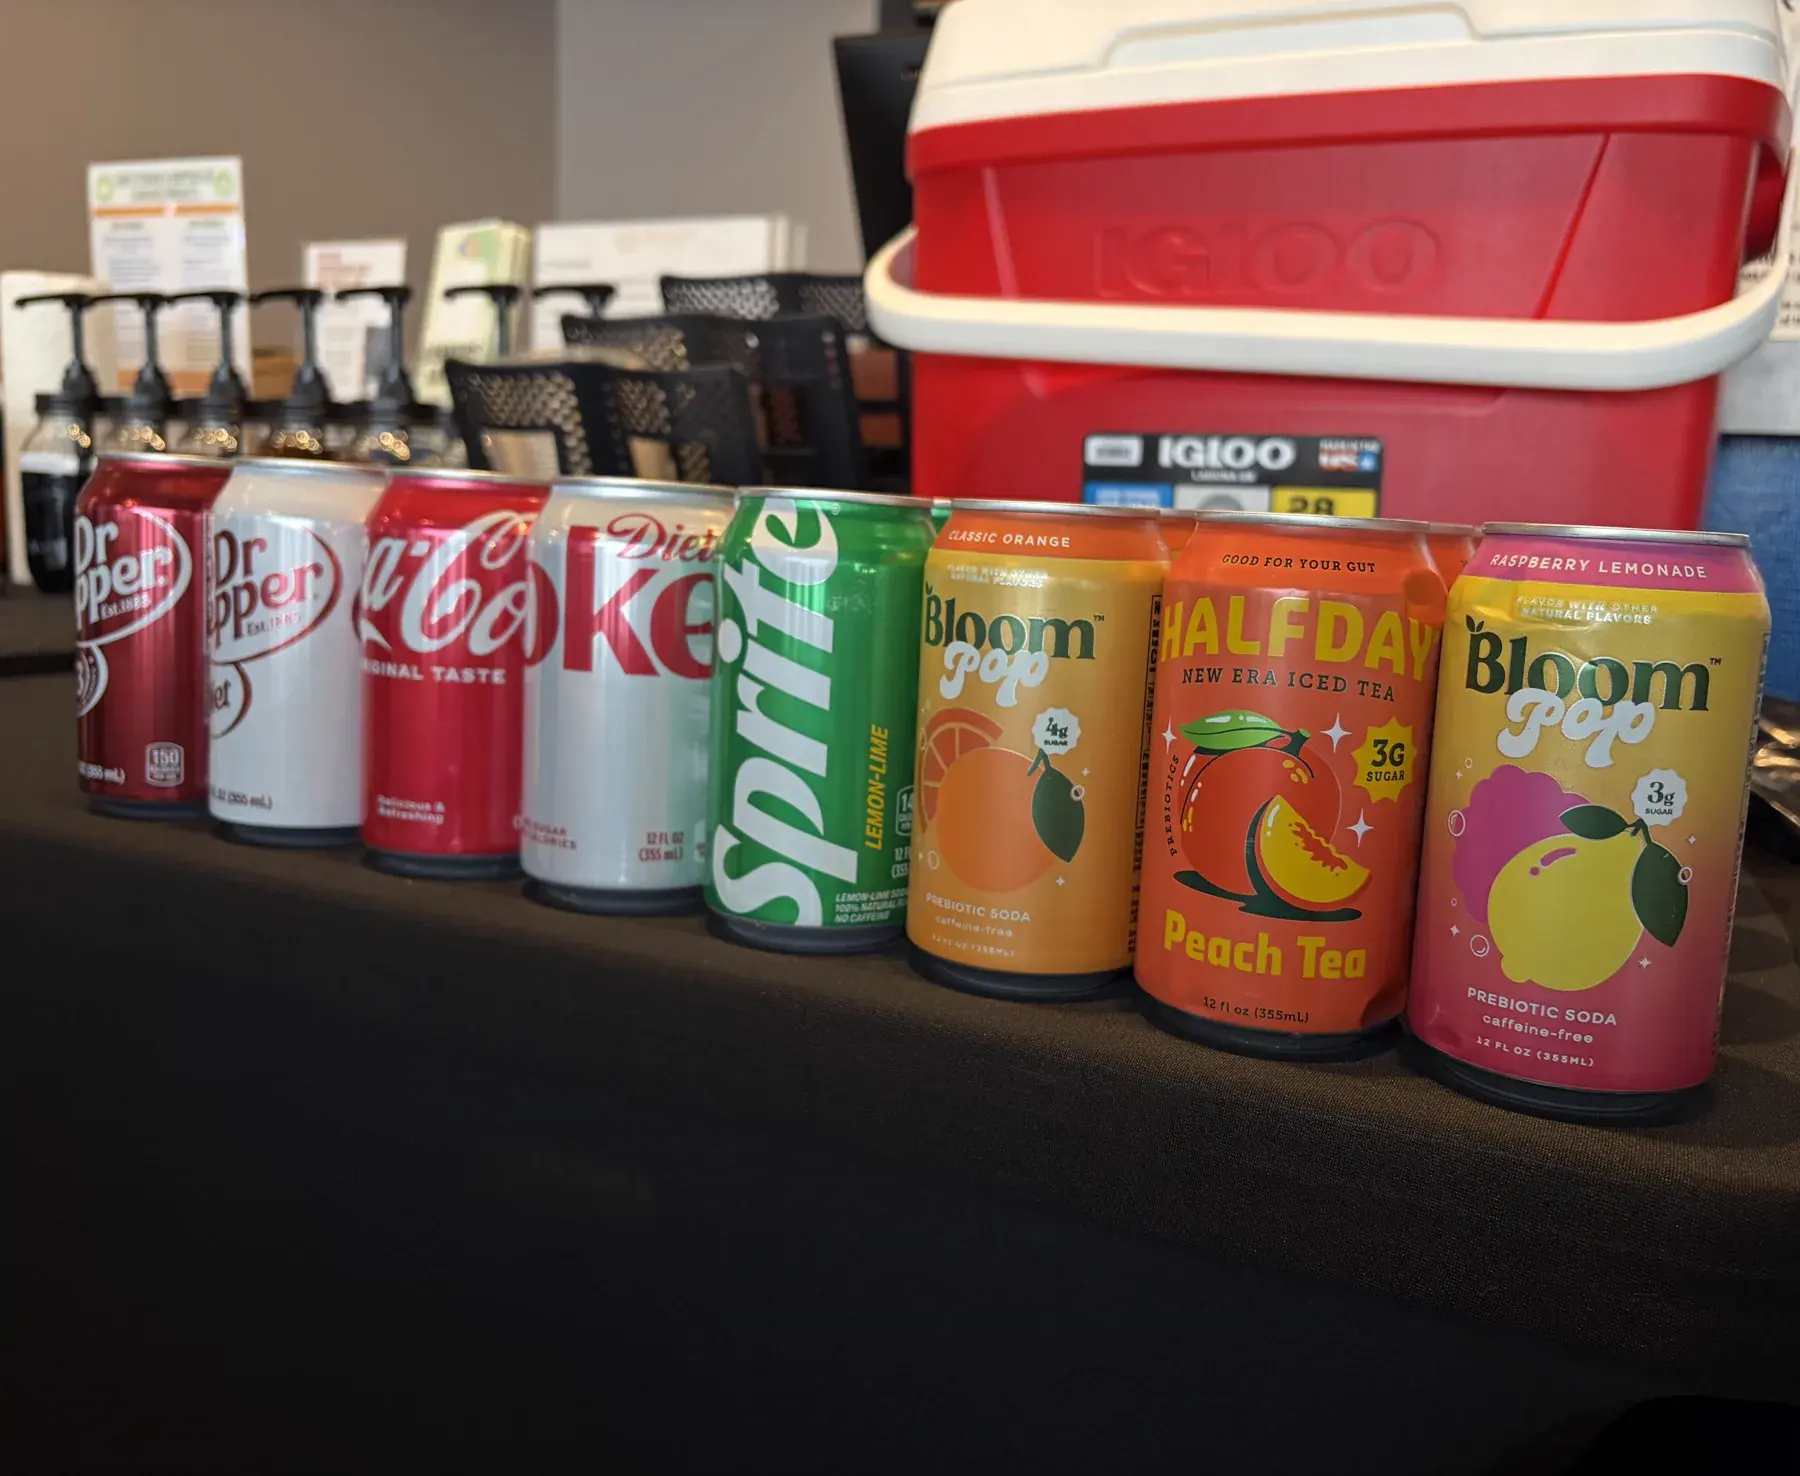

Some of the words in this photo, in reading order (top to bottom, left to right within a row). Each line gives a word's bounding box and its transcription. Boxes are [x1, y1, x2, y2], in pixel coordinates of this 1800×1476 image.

[75, 515, 120, 574] Dr
[606, 513, 719, 562] Diet
[948, 529, 999, 544] CLASSIC
[1002, 533, 1071, 548] ORANGE
[213, 529, 269, 588] Dr
[1220, 553, 1261, 567] GOOD
[1263, 556, 1294, 569] FOR
[1300, 558, 1343, 572] YOUR
[1346, 561, 1377, 574] GUT
[1489, 553, 1591, 572] RASPBERRY
[1598, 560, 1708, 579] LEMONADE
[924, 594, 1096, 660] Bloom
[1521, 607, 1581, 621] NATURAL
[1586, 612, 1653, 625] FLAVORS
[1160, 595, 1432, 682] HALFDAY
[431, 664, 508, 684] TASTE
[939, 641, 1050, 708] Pop
[1182, 666, 1224, 684] NEW
[1231, 667, 1278, 686] ERA
[1286, 671, 1347, 693] ICED
[1356, 680, 1397, 703] TEA
[1464, 631, 1711, 712] Bloom
[1496, 687, 1656, 768] Pop
[1370, 738, 1406, 769] 3G
[864, 723, 889, 851] LEMON-LIME
[1365, 770, 1406, 783] SUGAR
[1646, 781, 1676, 806] 3g
[1163, 753, 1180, 858] PREBIOTICS
[1644, 808, 1674, 816] SUGAR
[925, 892, 987, 917] PREBIOTIC
[989, 908, 1032, 922] SODA
[1163, 908, 1283, 977] Peach
[1296, 934, 1367, 980] Tea
[1203, 996, 1217, 1010] 12
[1220, 1000, 1230, 1013] fl
[1233, 1005, 1250, 1017] oz
[1253, 1006, 1310, 1024] (355mL)
[1467, 986, 1559, 1019] PREBIOTIC
[1564, 1008, 1617, 1026] SODA
[1482, 1014, 1594, 1044] caffeine-free
[1476, 1035, 1490, 1047] 12
[1494, 1041, 1510, 1052] FL
[1513, 1046, 1532, 1057] OZ
[1536, 1050, 1595, 1067] (355ML)
